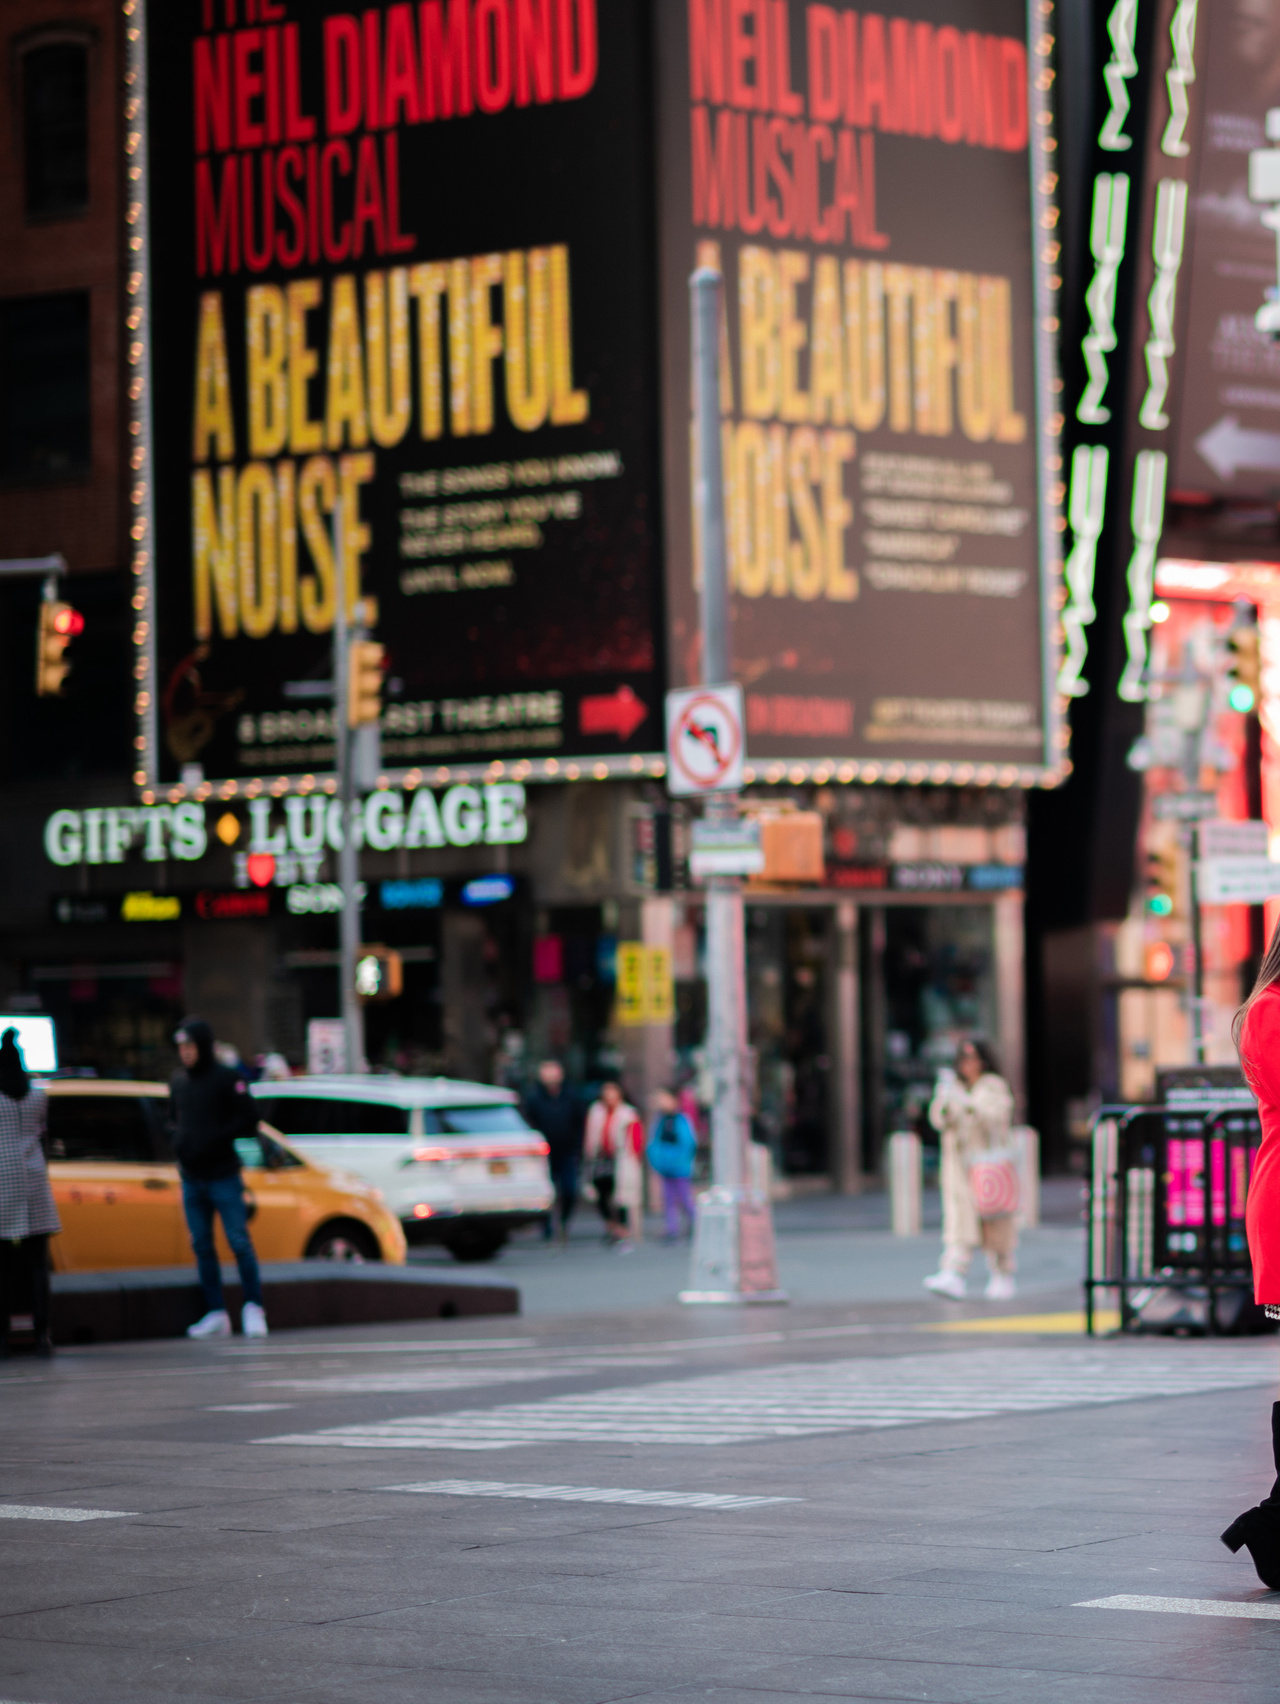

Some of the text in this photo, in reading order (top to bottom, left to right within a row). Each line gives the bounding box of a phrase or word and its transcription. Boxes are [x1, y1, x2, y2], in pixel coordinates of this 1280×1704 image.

[194, 0, 597, 154] NEIL DIAMOND
[688, 0, 1028, 152] NEIL DIAMOND
[196, 132, 415, 277] MUSICAL
[692, 105, 889, 251] MUSICAL
[193, 292, 234, 461] A
[246, 244, 588, 457] BEAUTIFUL
[739, 244, 1028, 443] BEAUTIFUL
[192, 452, 378, 639] NOISE
[442, 690, 563, 731] THEATRE
[45, 782, 527, 866] GIFTS LUGGAGE
